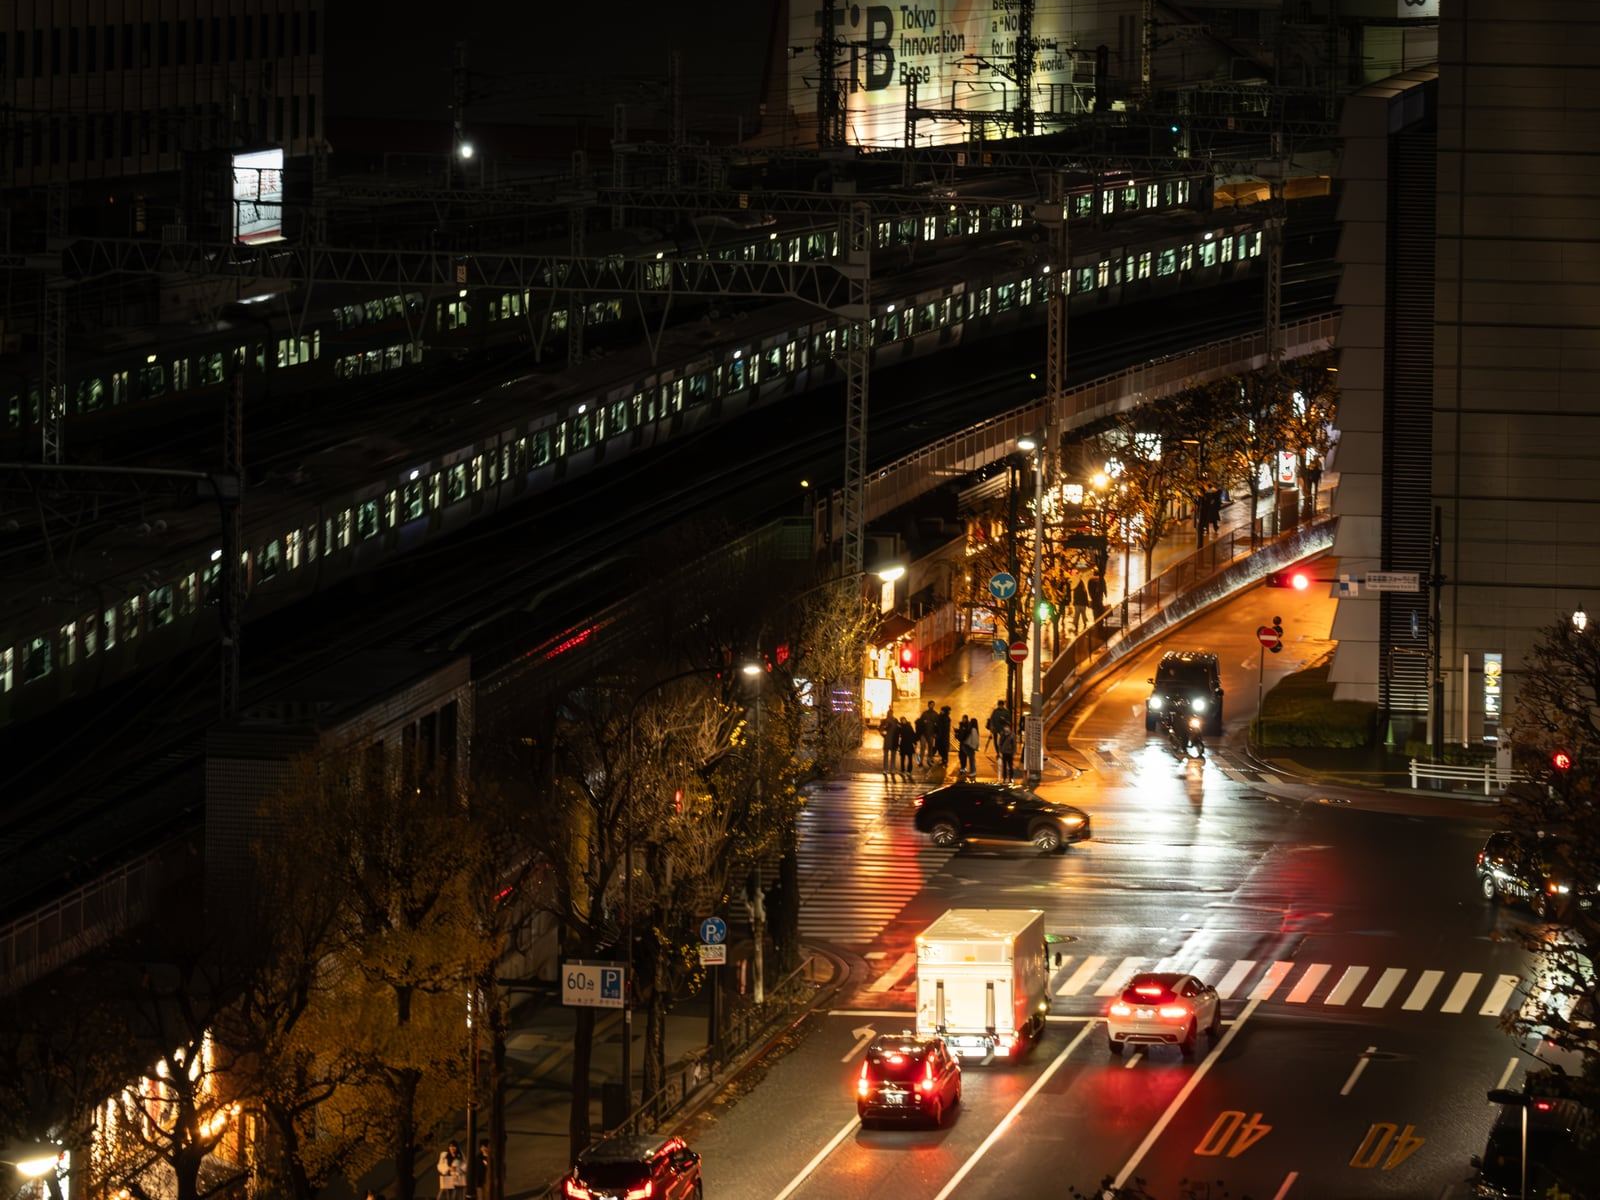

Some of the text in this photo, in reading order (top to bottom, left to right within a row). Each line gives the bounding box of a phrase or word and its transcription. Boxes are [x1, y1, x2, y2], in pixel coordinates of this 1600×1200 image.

[901, 5, 936, 33] Tokyo
[992, 21, 997, 32] a
[900, 30, 965, 57] Innovation
[992, 39, 1003, 55] for
[900, 61, 930, 86] Base
[705, 925, 718, 943] P
[606, 971, 617, 988] P
[1193, 1110, 1273, 1159] 40
[1349, 1121, 1426, 1171] 40
